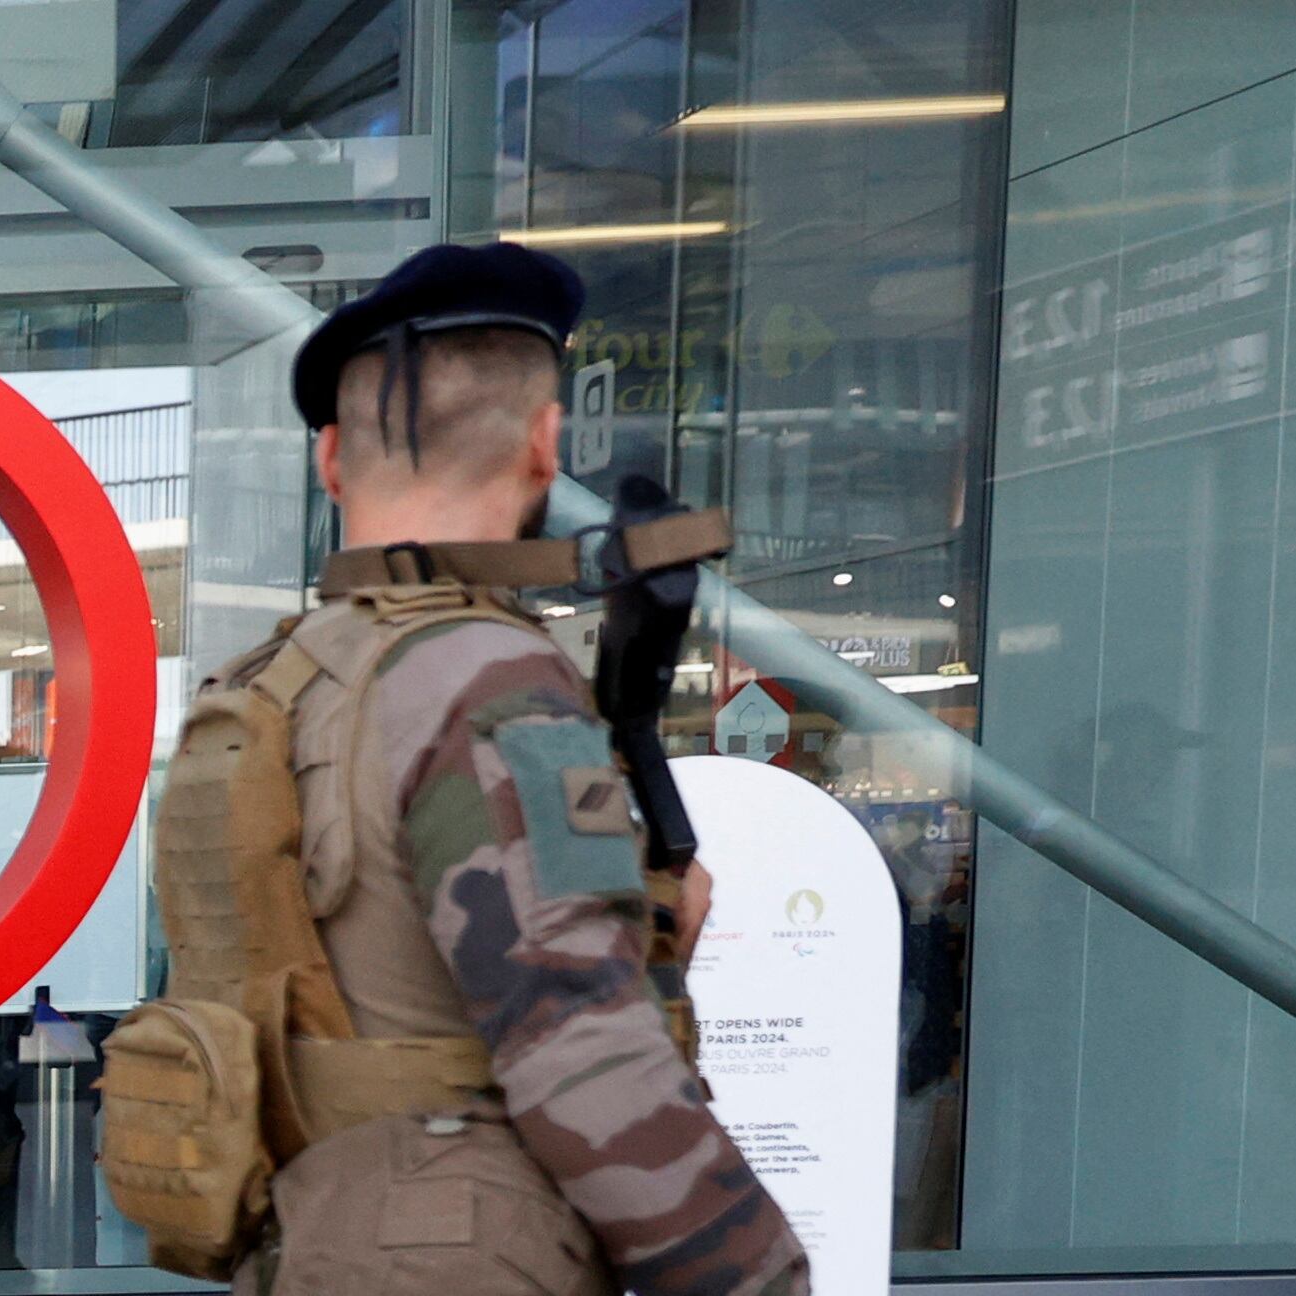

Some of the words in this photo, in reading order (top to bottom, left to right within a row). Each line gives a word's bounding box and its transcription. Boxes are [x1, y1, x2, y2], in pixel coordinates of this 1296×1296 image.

[565, 318, 706, 372] four
[701, 932, 744, 941] ROPORT
[695, 1019, 711, 1031] RT
[715, 1018, 761, 1030] OPENS
[767, 1017, 804, 1028] WIDE
[706, 1034, 747, 1045] PARIS
[752, 1033, 789, 1044] 2024.
[696, 1049, 724, 1061] OUS
[727, 1047, 776, 1060] OUVRE
[780, 1046, 830, 1059] GRAND
[710, 1063, 749, 1075] PARIS
[753, 1062, 789, 1075] 2024.
[733, 1123, 745, 1131] de
[753, 1133, 789, 1142] Games,
